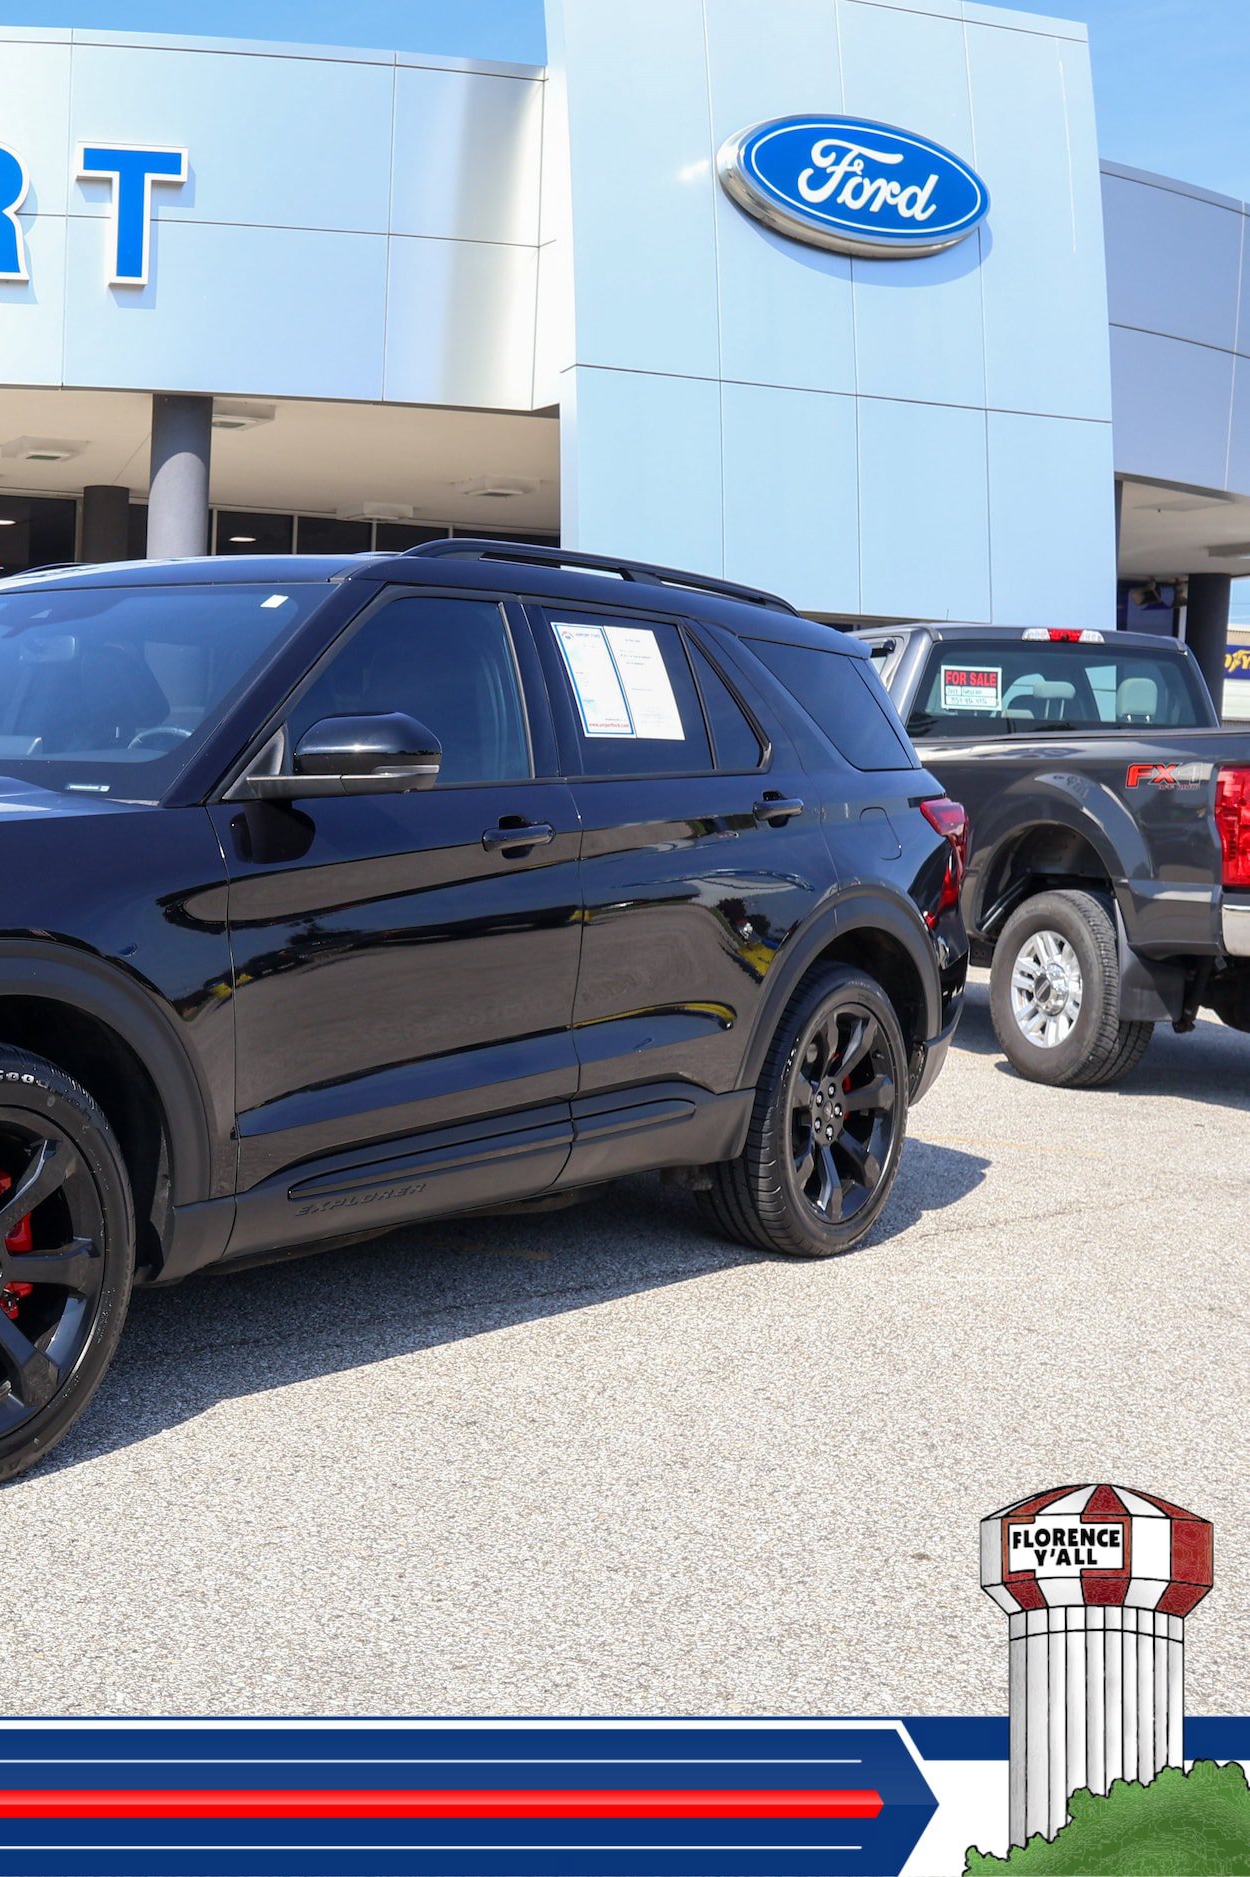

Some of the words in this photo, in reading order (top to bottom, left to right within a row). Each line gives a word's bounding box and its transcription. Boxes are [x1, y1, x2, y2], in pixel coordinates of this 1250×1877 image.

[797, 138, 940, 221] Ford
[945, 671, 967, 686] FOR
[969, 671, 997, 687] SALE
[295, 1183, 428, 1217] EXPLORER
